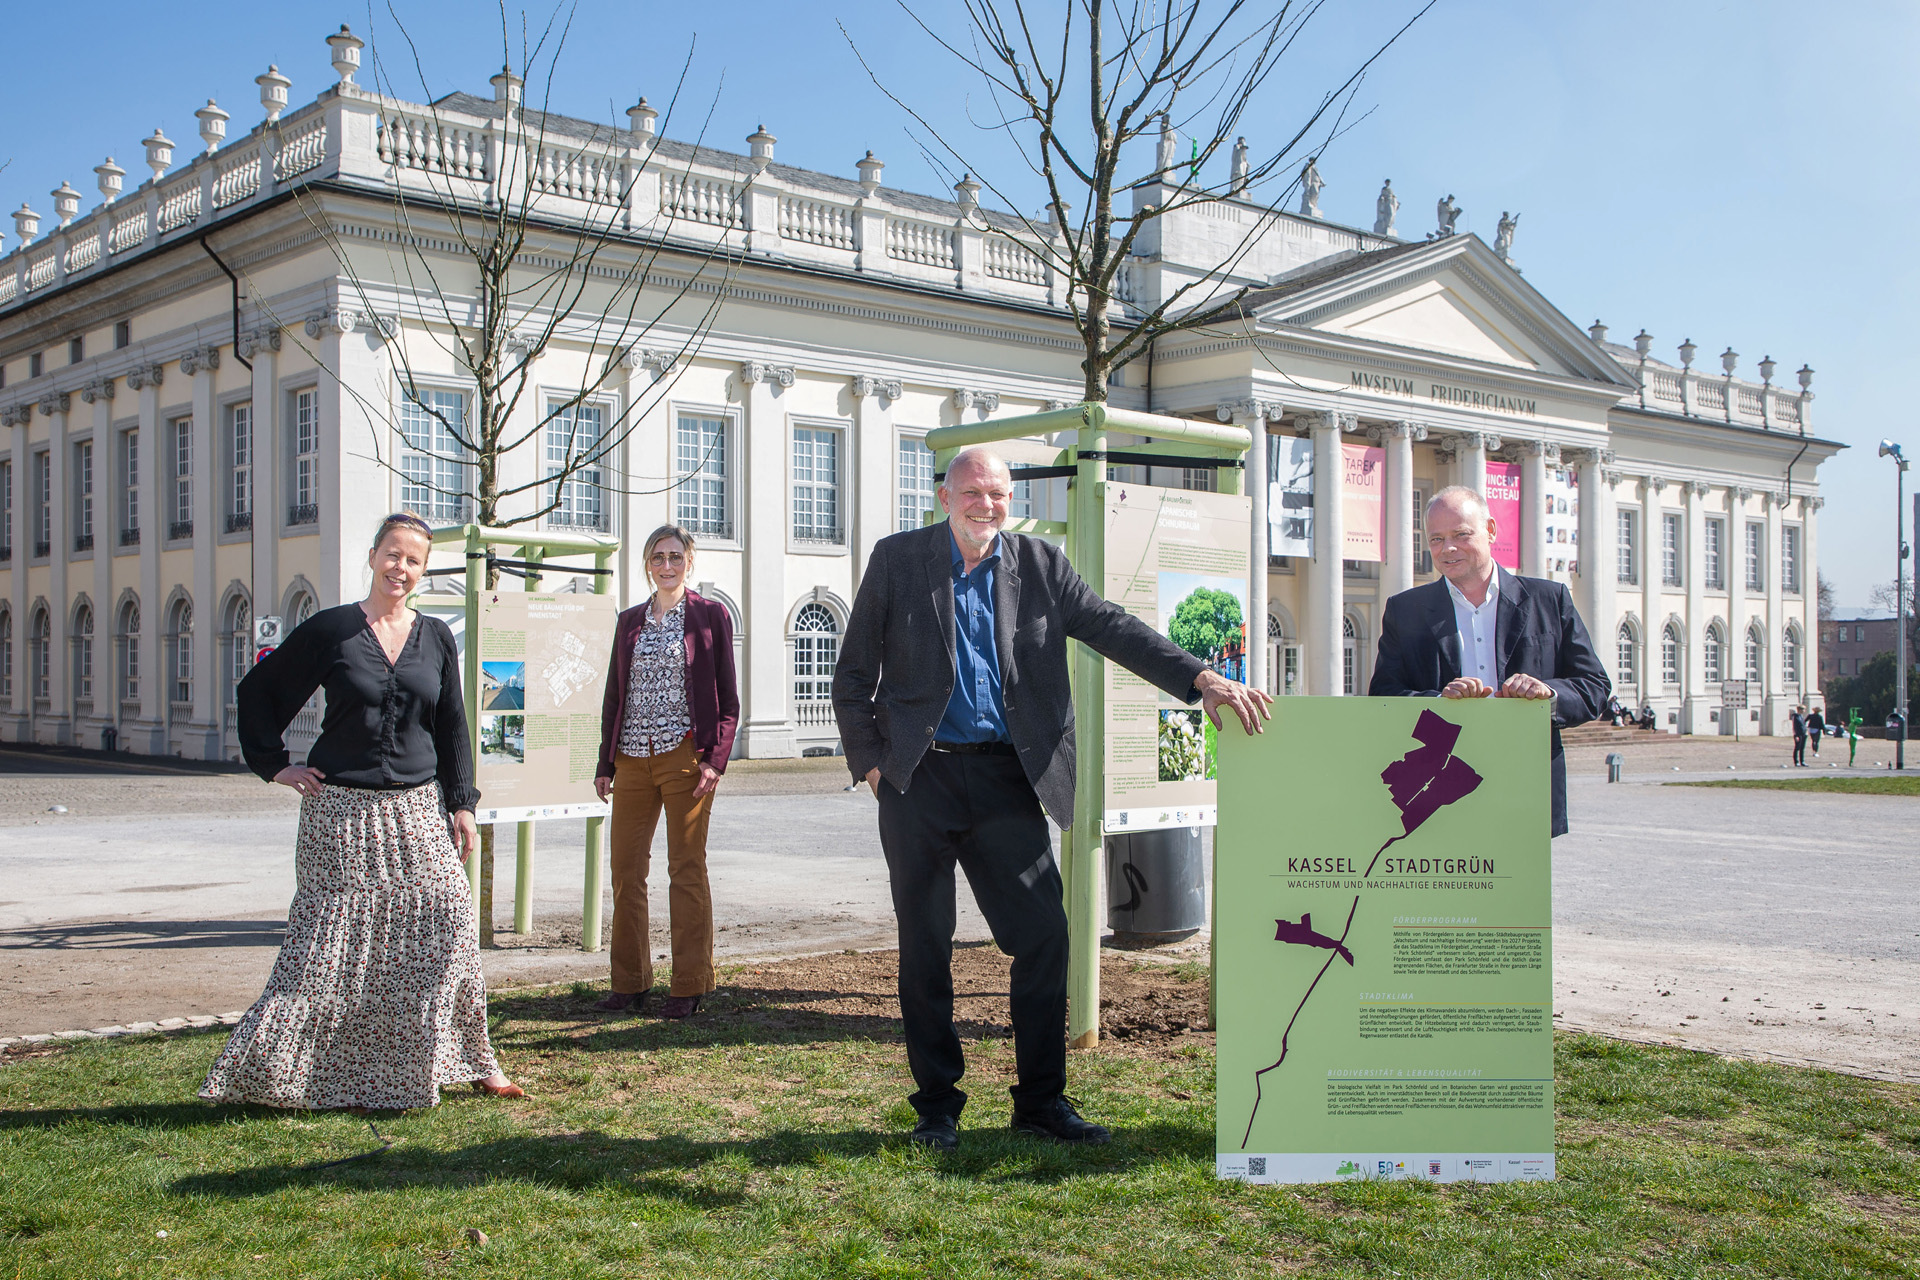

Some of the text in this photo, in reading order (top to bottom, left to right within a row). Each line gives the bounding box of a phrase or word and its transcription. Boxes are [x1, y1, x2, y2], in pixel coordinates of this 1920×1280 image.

[1351, 371, 1536, 416] MVSEVM FRIDERICIANVM
[1345, 458, 1375, 472] TAREK
[1345, 473, 1374, 486] ATOUI
[1288, 856, 1494, 874] KASSEL STADTGRÜN
[1433, 881, 1494, 889] ERNEUERUNG
[1407, 1069, 1482, 1077] LEBENSQUALITÄT
